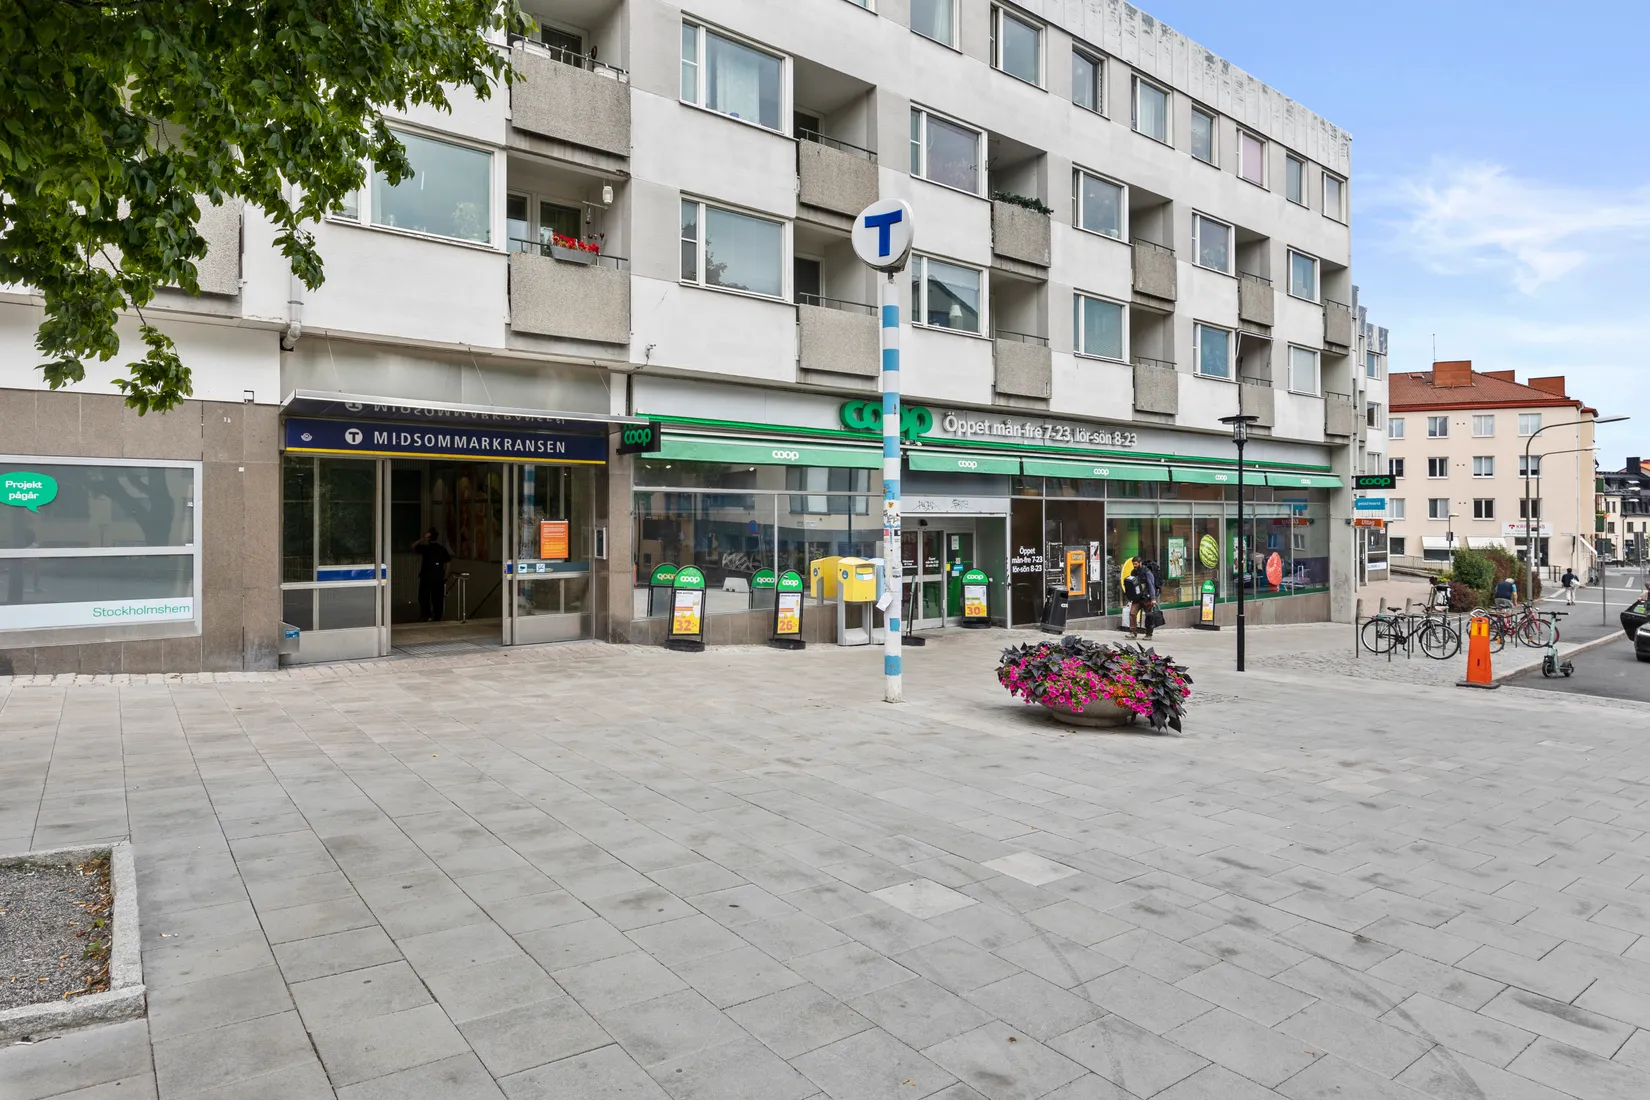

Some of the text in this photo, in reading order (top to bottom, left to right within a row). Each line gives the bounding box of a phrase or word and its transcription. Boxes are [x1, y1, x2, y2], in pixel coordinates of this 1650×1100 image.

[864, 210, 903, 257] T
[944, 411, 1138, 446] Öppet mån-fre 7-23, lör-sön 8-23
[624, 428, 652, 446] coop
[374, 431, 566, 454] MIDSOMMARKRANSEN
[772, 450, 800, 461] coop
[957, 459, 978, 469] coop
[1093, 468, 1110, 476] coop
[5, 480, 43, 490] Projekt
[1359, 477, 1391, 486] coop
[8, 491, 40, 501] pågår
[1019, 545, 1036, 556] Öppet
[1011, 555, 1043, 564] mån-fre 7-23
[1012, 564, 1043, 573] lör-sön 8-23
[680, 575, 700, 584] coop
[782, 579, 799, 587] coop
[92, 604, 190, 618] Stockholmshem
